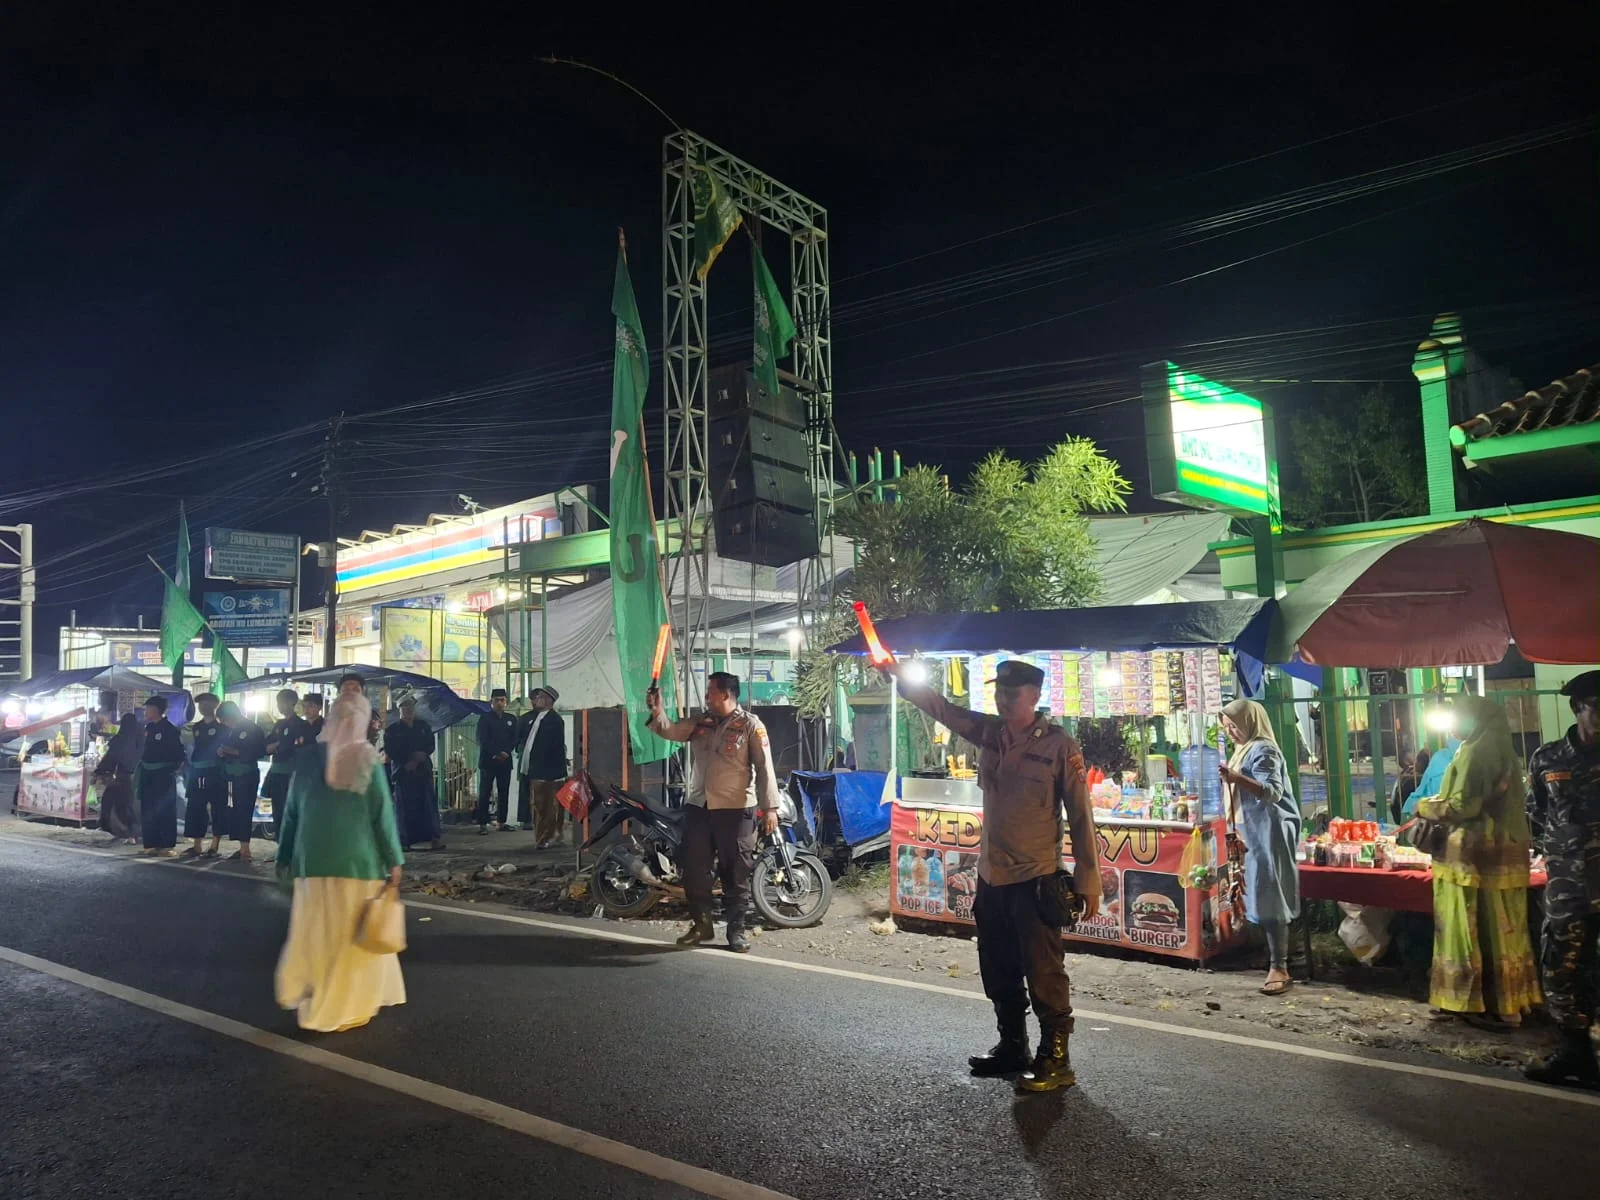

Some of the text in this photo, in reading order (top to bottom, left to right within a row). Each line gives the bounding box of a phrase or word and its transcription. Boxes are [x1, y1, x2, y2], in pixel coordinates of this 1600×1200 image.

[470, 595, 489, 610] ATM
[917, 808, 980, 847] KED
[901, 895, 941, 915] POP ICE
[956, 895, 973, 908] SO
[1131, 928, 1180, 949] BURGER
